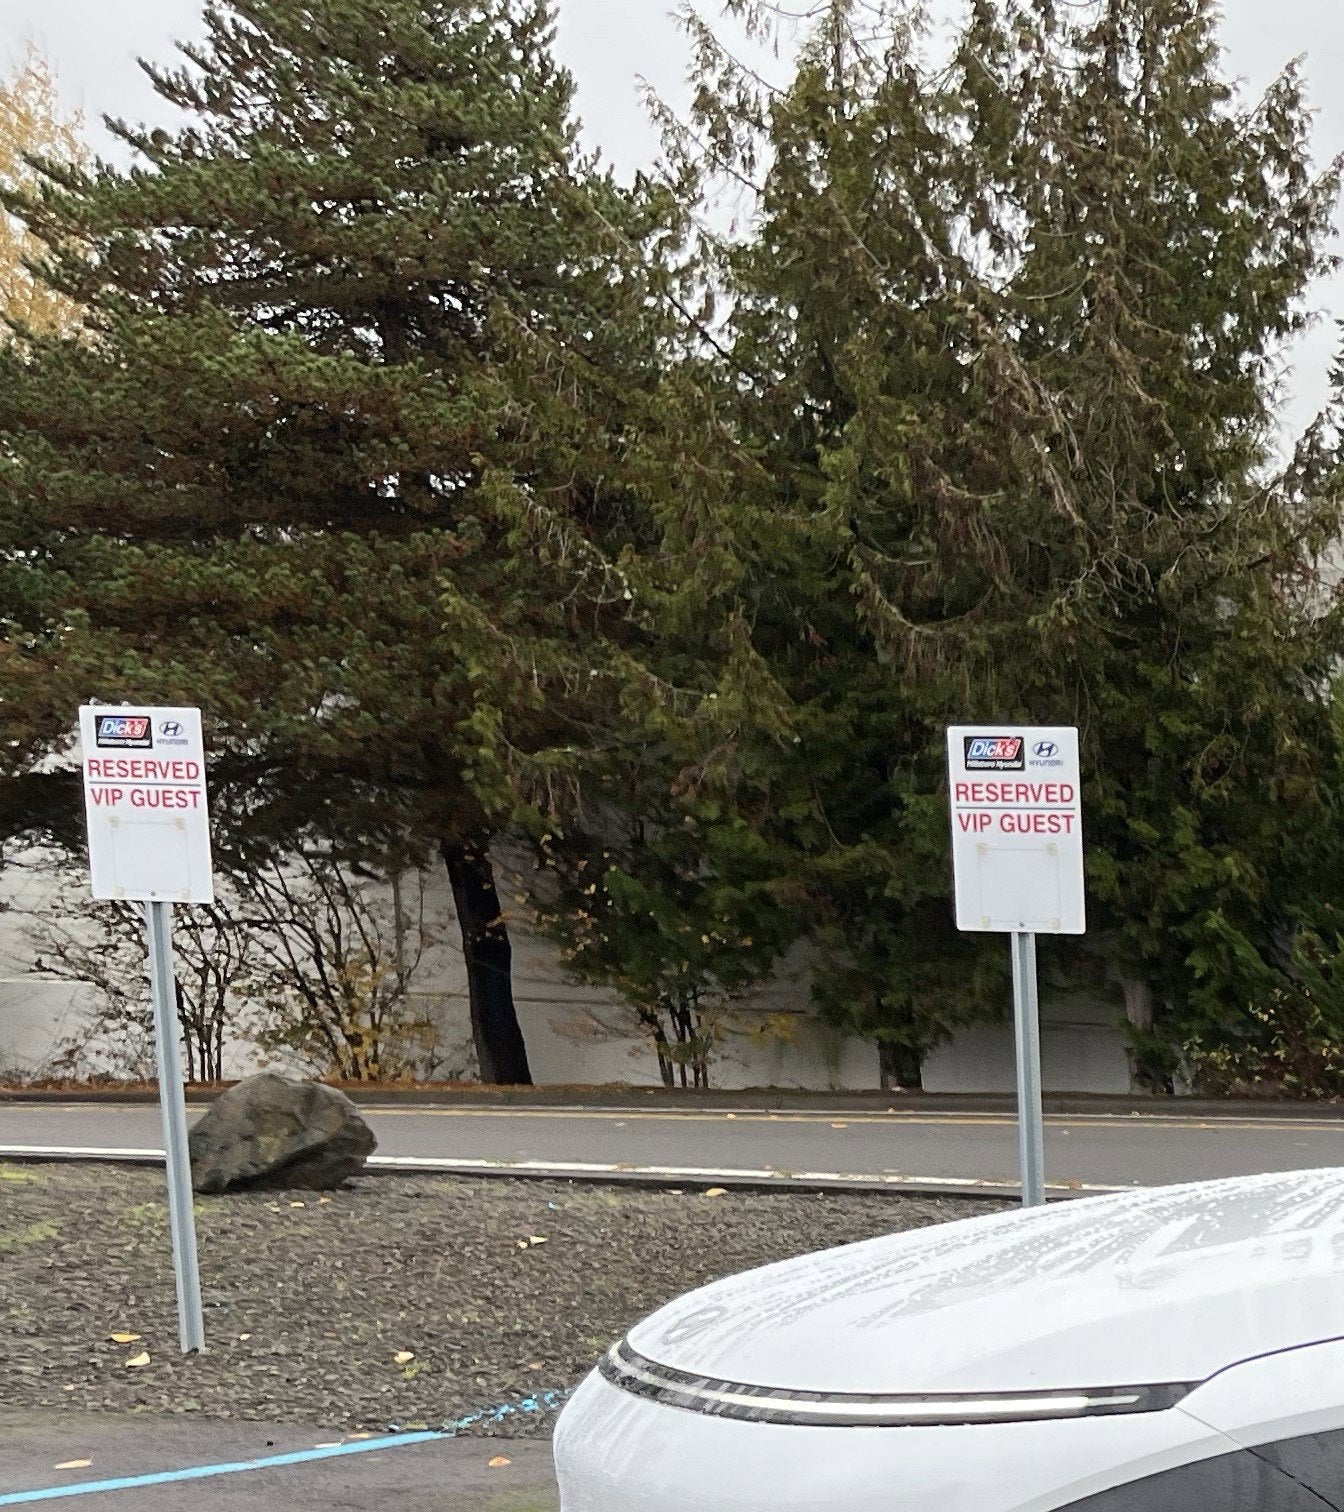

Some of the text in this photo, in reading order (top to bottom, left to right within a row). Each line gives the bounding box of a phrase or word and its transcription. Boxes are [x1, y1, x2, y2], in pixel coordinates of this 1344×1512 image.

[87, 759, 200, 780] RESERVED
[90, 788, 201, 809] VIP GUEST
[956, 783, 1074, 803] RESERVED
[958, 814, 1075, 834] VIP GUEST
